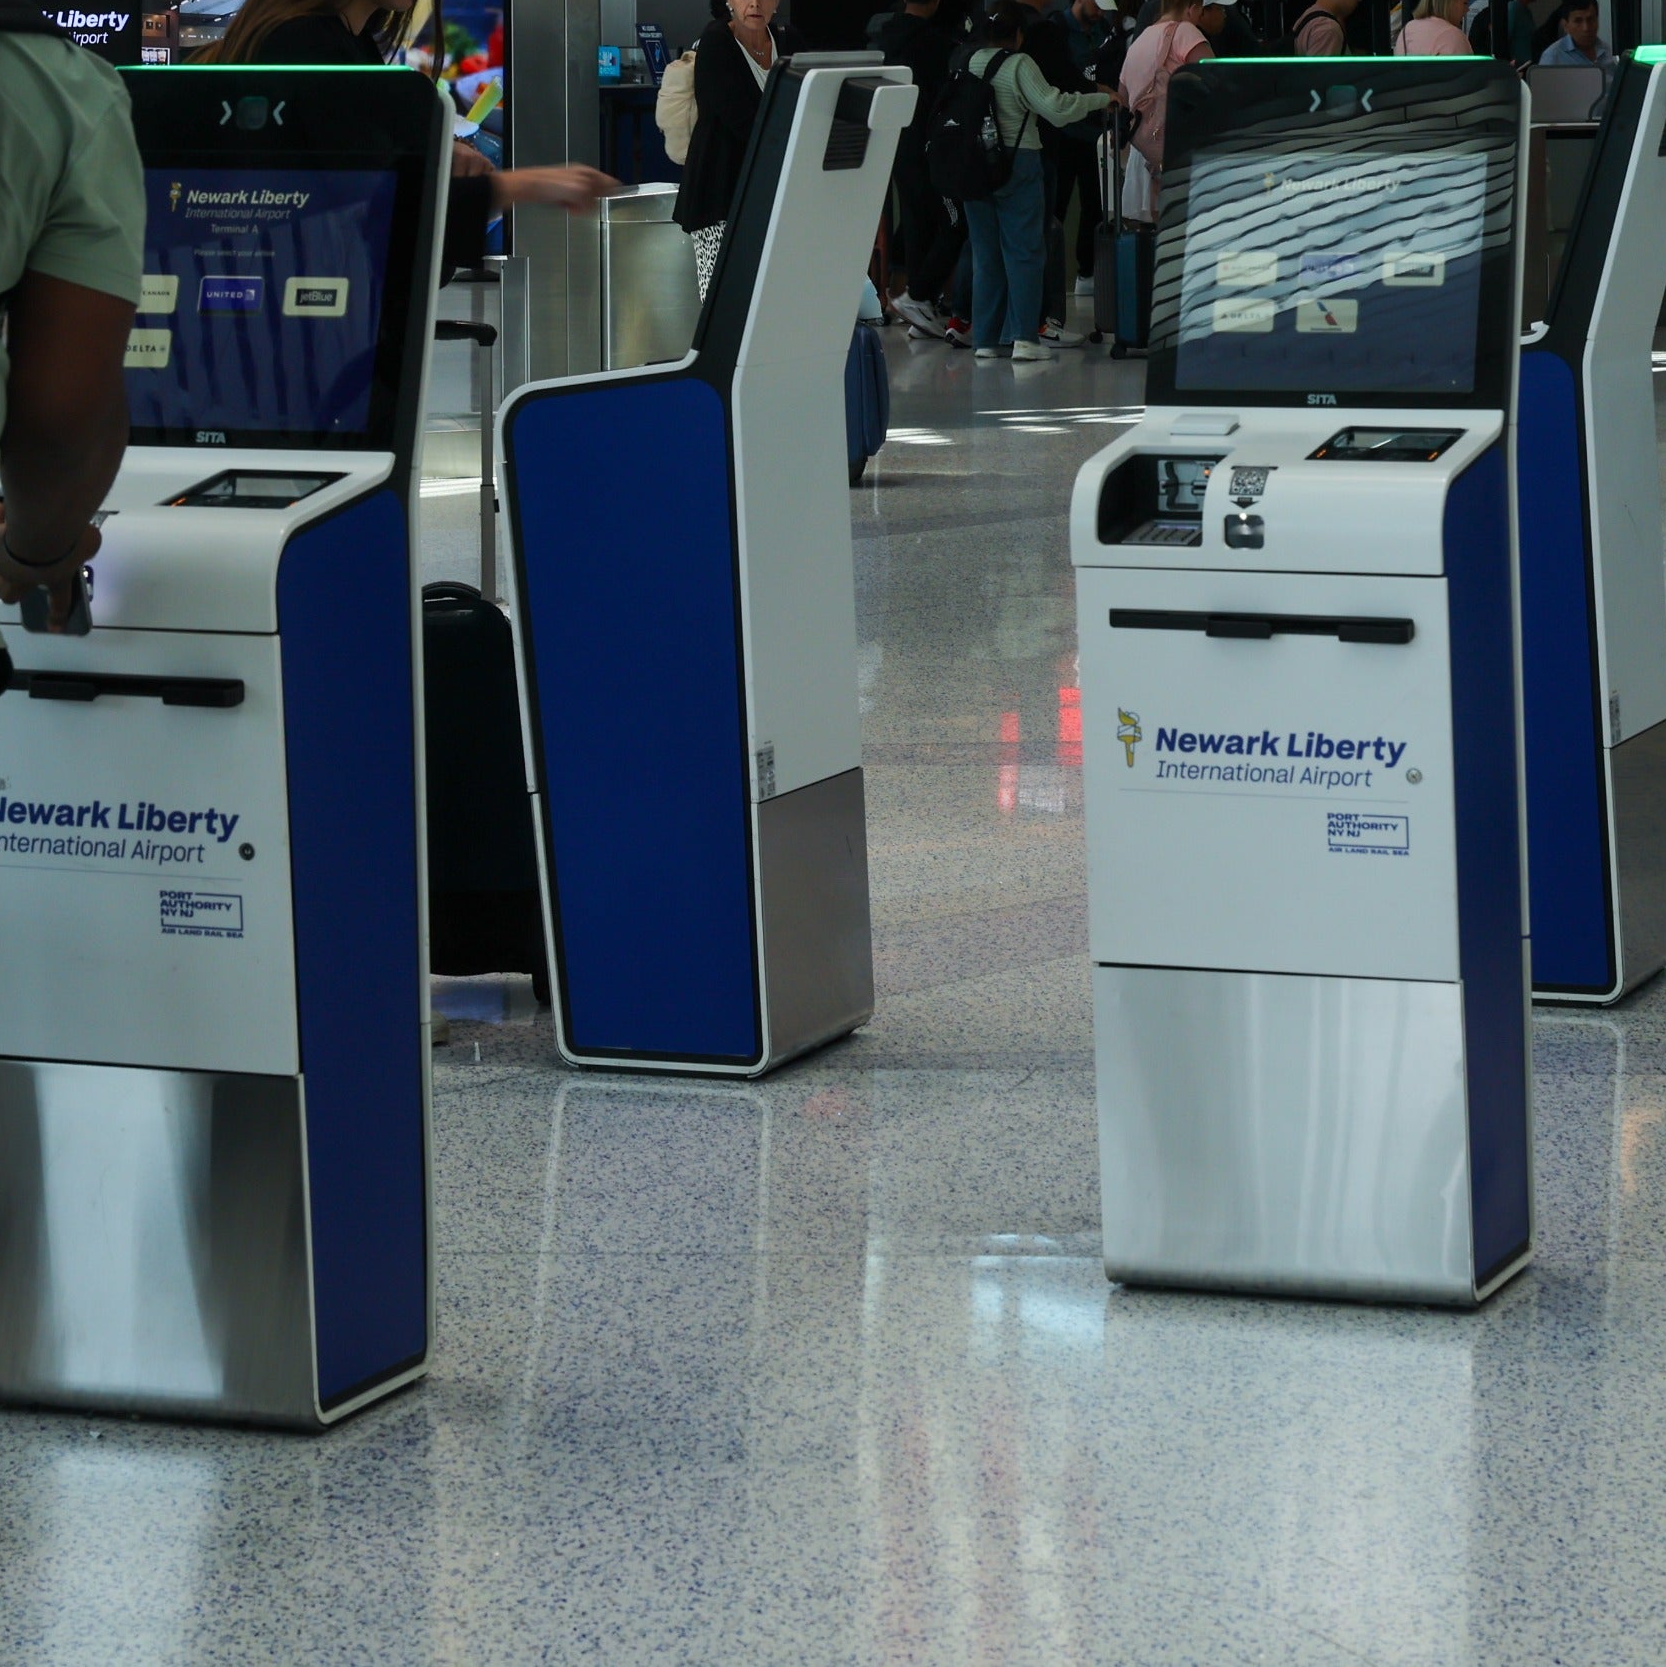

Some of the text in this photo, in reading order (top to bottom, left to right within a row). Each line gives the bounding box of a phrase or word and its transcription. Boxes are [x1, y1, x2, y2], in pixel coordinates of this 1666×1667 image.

[57, 10, 129, 31] Liberty
[187, 190, 310, 208] Newark Liberty
[1307, 394, 1337, 405] SITA
[196, 431, 226, 444] SITA
[1155, 728, 1407, 767] Newark Liberty
[1155, 761, 1373, 789] International Airport
[118, 802, 239, 842] Liberty
[1327, 813, 1360, 821] PORT
[1328, 821, 1398, 830] AUTHORITY
[131, 839, 205, 865] Airport
